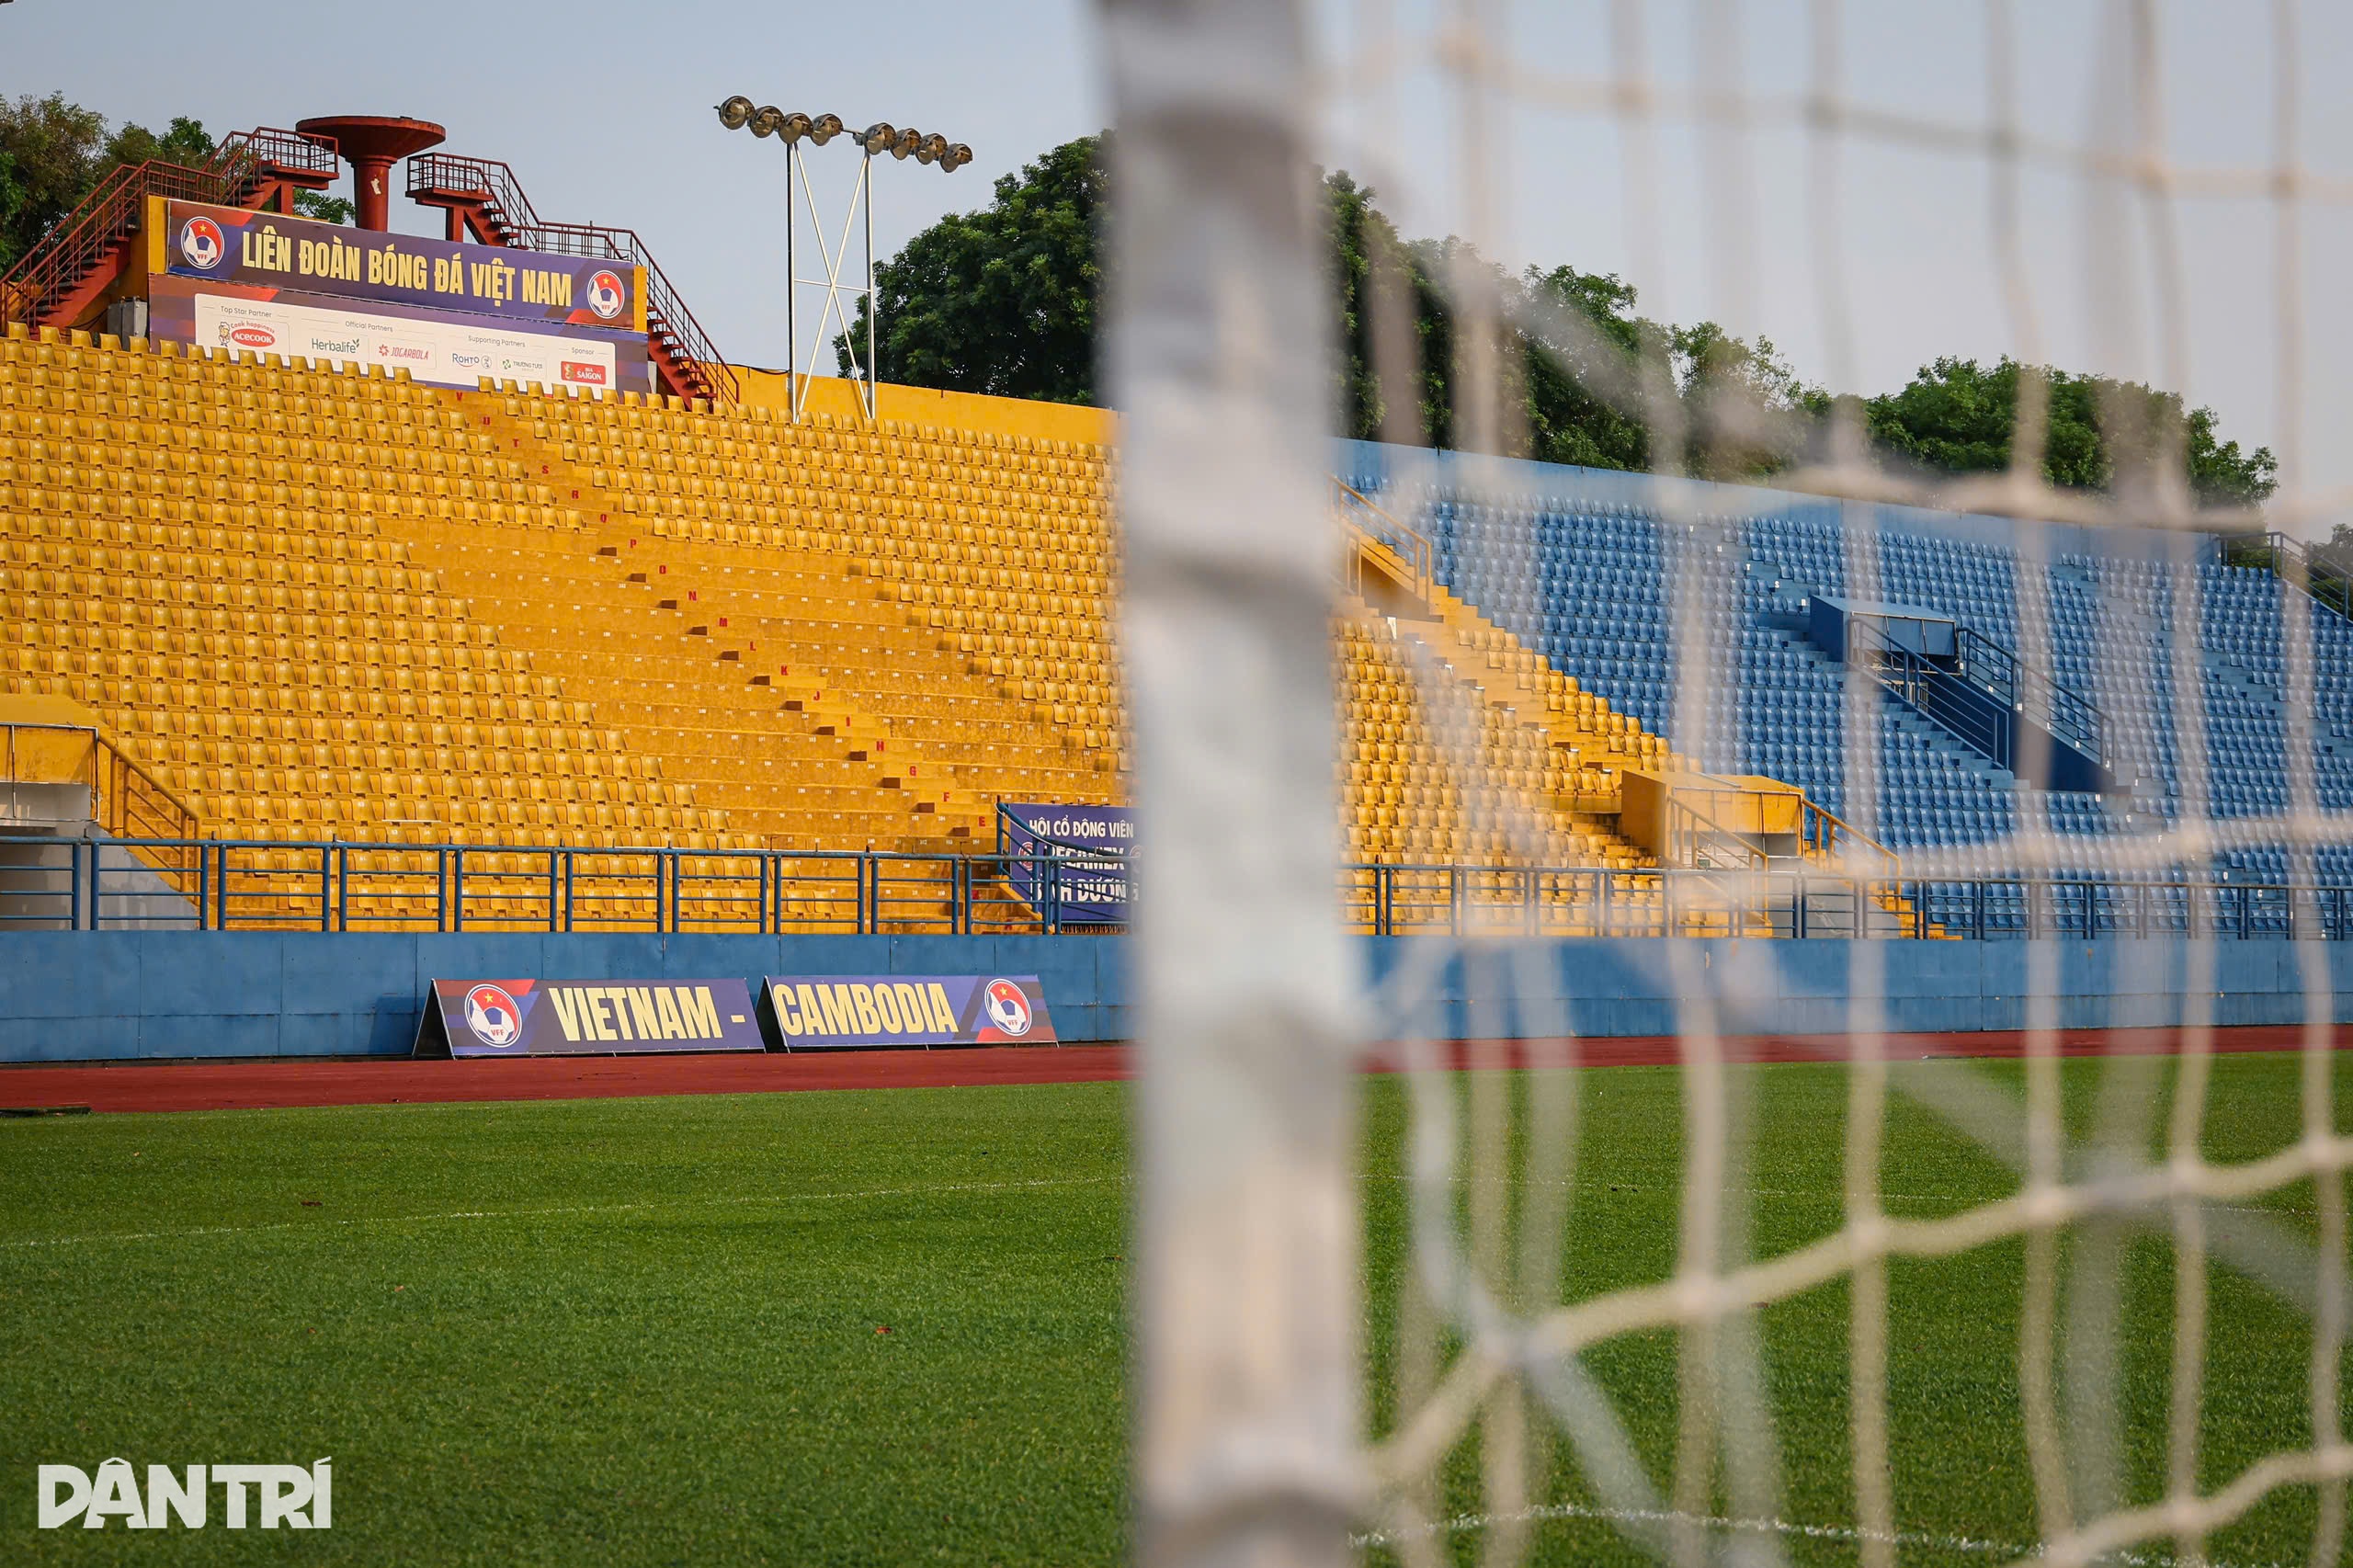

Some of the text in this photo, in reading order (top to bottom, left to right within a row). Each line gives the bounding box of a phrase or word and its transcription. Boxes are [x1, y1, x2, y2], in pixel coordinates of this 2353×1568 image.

[242, 224, 572, 307] LIÊN ĐOÀN BÓNG ĐÁ VIỆT NAM
[221, 305, 272, 318] Top Star Partner
[231, 321, 275, 335] Cook happiness
[345, 321, 393, 333] Official Partners
[312, 338, 357, 354] Herbalife
[468, 335, 526, 347] Supporting Partners
[391, 347, 429, 360] JOGARBOLA
[572, 347, 595, 356] Sponsor
[576, 370, 602, 381] SAIGON
[456, 392, 463, 401] V
[512, 438, 519, 448] T
[541, 465, 549, 474] S
[630, 539, 637, 548] P
[688, 590, 697, 601] N
[719, 617, 728, 628] M
[749, 641, 756, 651] L
[780, 665, 789, 676] K
[978, 816, 986, 826] E
[1053, 814, 1070, 836] CỔ
[1073, 818, 1106, 839] ĐỘNG
[1108, 820, 1133, 838] VIÊN
[548, 986, 723, 1040] VIETNAM
[773, 983, 959, 1036] CAMBODIA
[490, 1028, 505, 1037] VFF
